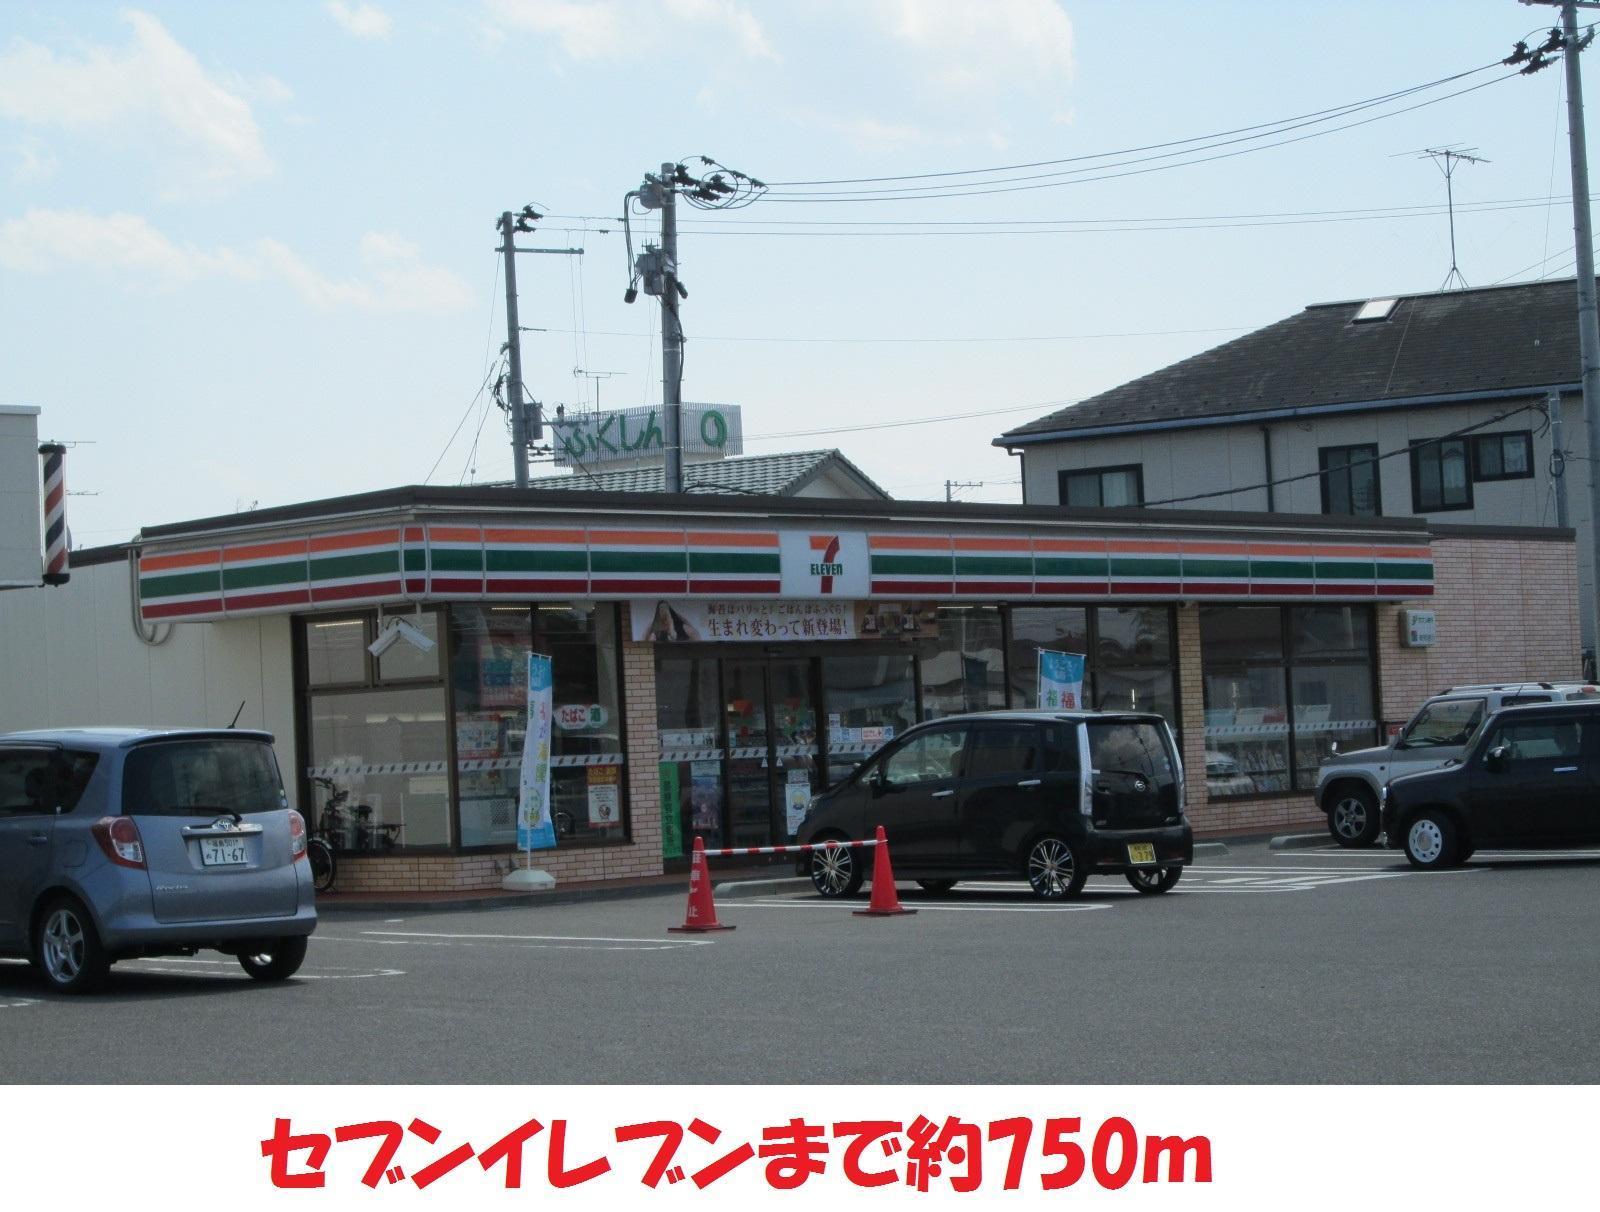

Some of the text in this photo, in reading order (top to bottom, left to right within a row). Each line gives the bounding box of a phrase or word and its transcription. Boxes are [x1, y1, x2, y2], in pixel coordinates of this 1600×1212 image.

[809, 536, 840, 593] 7
[561, 708, 586, 723] たばこ
